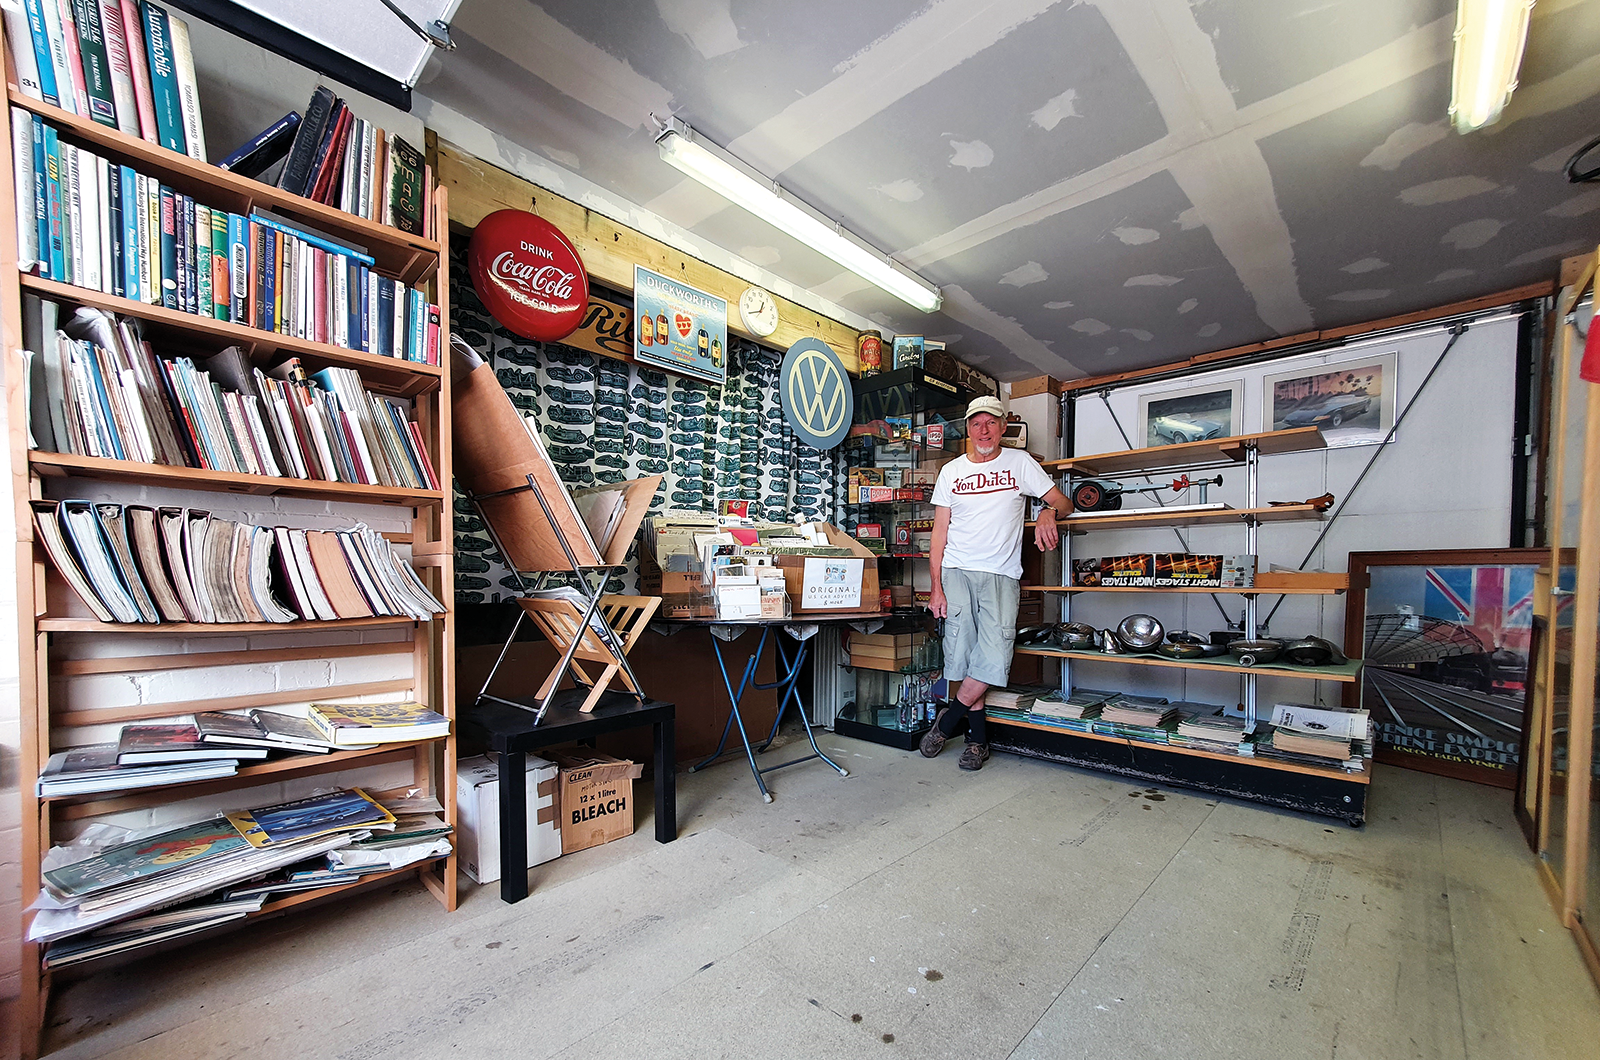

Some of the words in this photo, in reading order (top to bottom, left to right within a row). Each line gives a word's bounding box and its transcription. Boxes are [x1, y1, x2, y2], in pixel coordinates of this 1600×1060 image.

[90, 24, 102, 46] FLAG
[148, 4, 172, 78] Automobile
[22, 78, 39, 90] 31
[48, 153, 58, 182] LION
[136, 190, 145, 208] Racing
[138, 216, 146, 249] International
[520, 240, 554, 260] DRINK
[491, 251, 576, 300] Coca-Cola
[646, 276, 718, 312] DUCKWORTH'S
[953, 478, 976, 492] Von
[976, 470, 1016, 489] Dutch
[910, 520, 934, 528] ZEST
[1101, 577, 1128, 586] STAGES
[1128, 577, 1153, 586] NIGHT
[1156, 578, 1190, 586] STAGES
[1190, 578, 1220, 586] NIGHT
[1374, 722, 1437, 740] VENICE
[1393, 745, 1427, 756] LONDON
[1435, 752, 1461, 762] PARIS
[1469, 758, 1505, 770] VENICE
[569, 771, 592, 782] CLEAN
[580, 795, 588, 803] 12
[602, 789, 617, 798] litre
[572, 797, 626, 825] BLEACH
